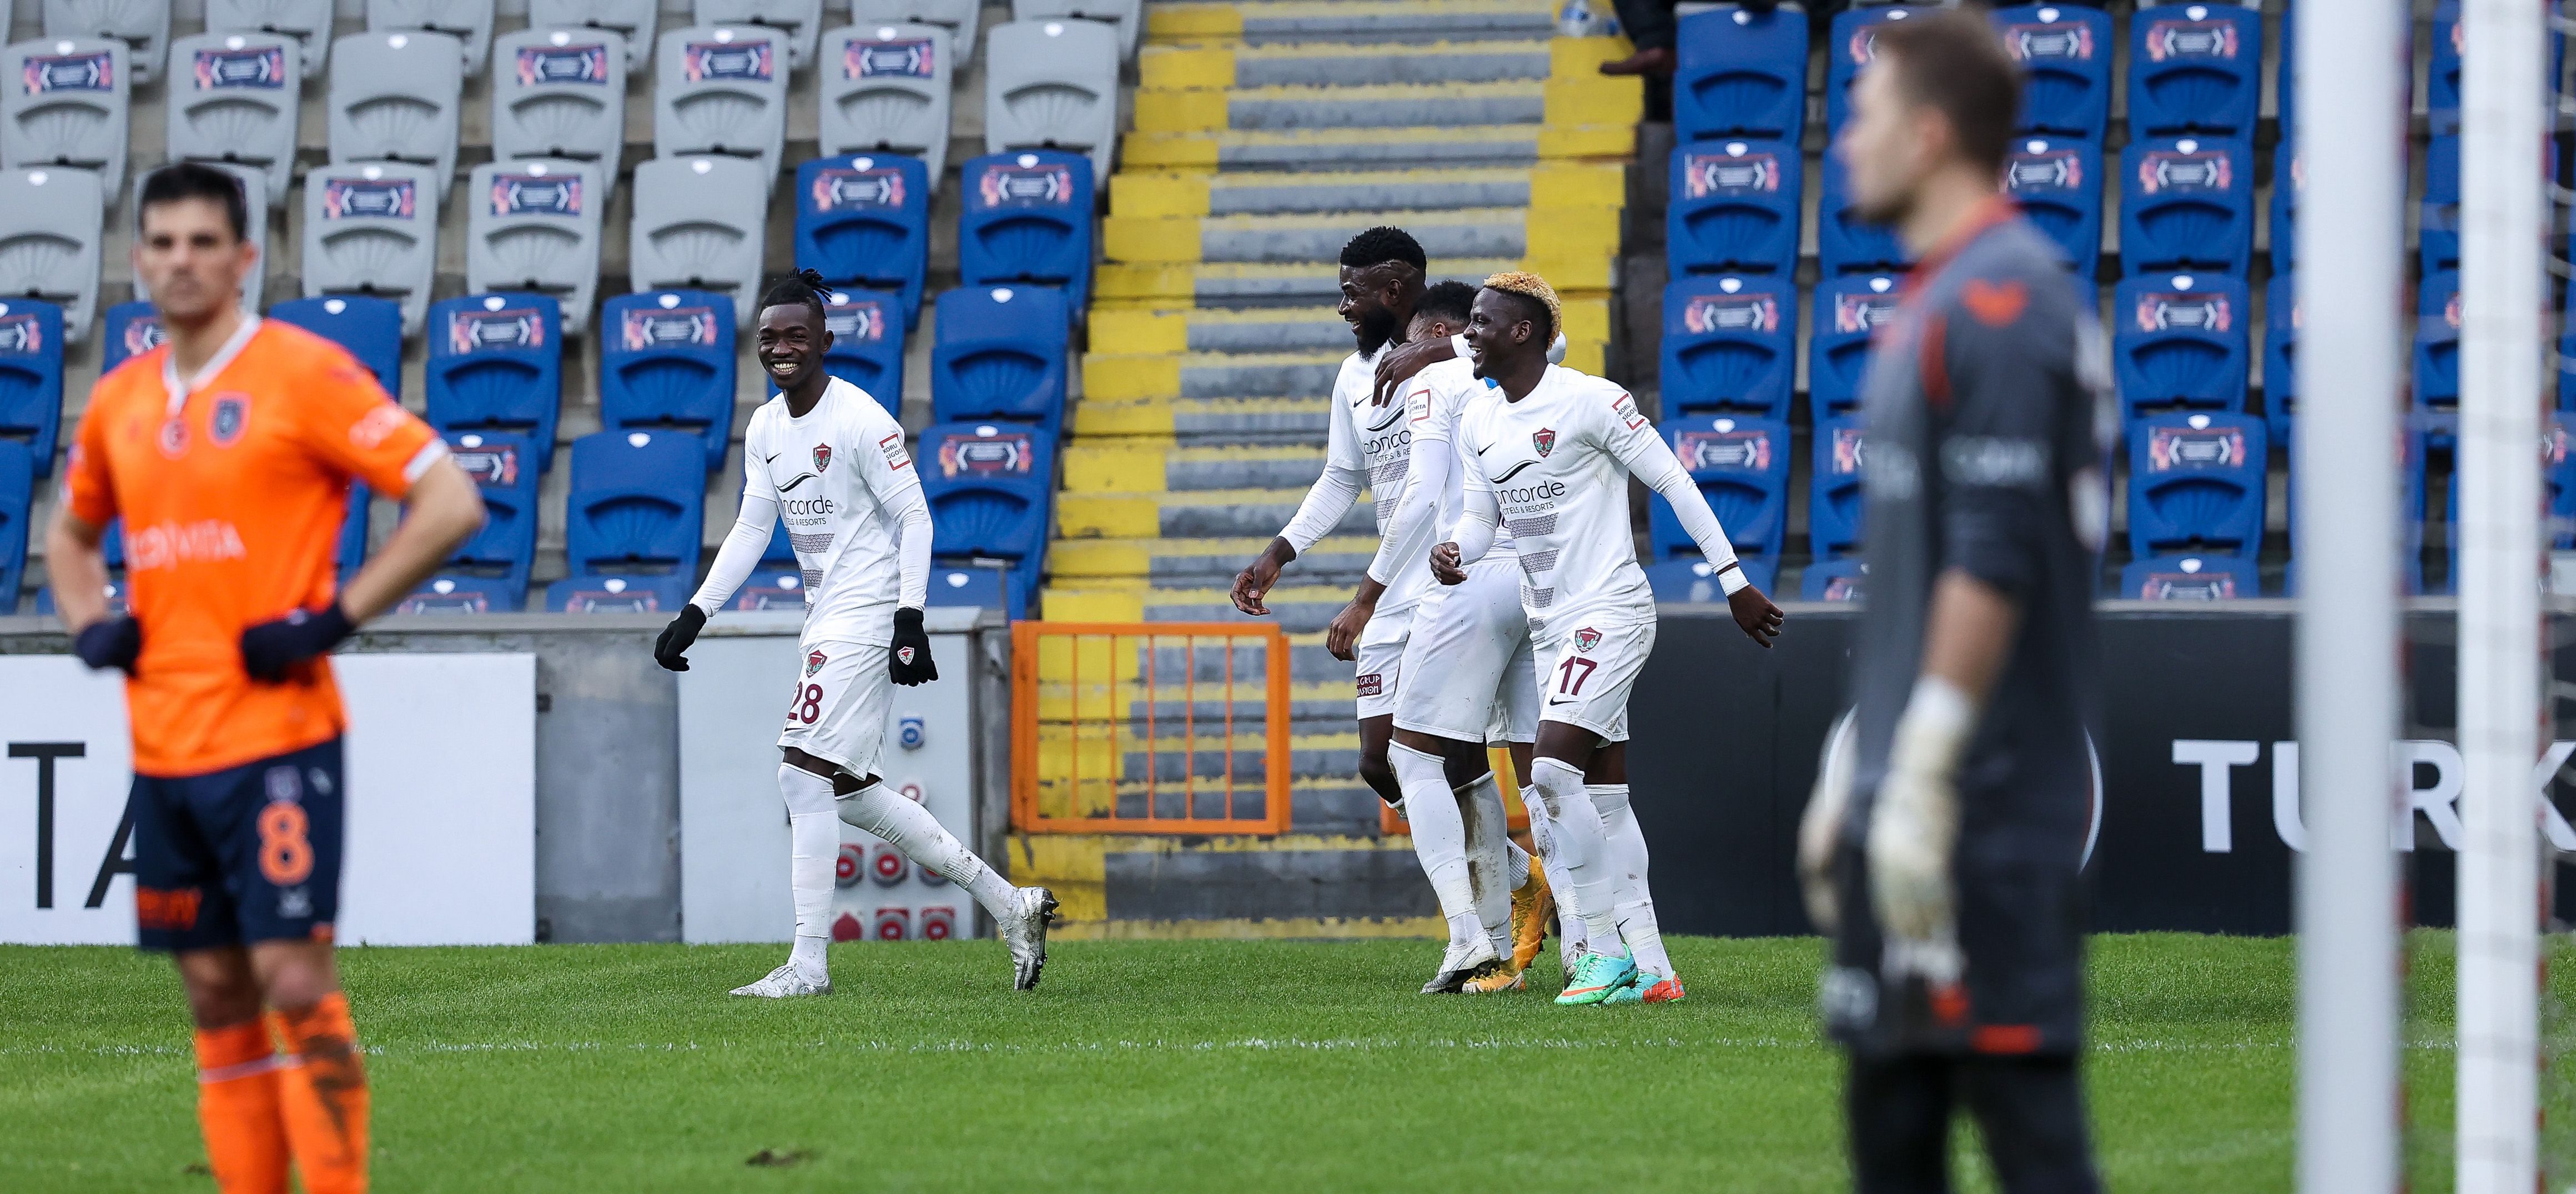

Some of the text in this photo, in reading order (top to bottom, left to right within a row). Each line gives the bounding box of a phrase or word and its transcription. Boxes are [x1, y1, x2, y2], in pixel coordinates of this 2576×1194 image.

[1618, 403, 1631, 416] KORU
[882, 443, 898, 454] KORU
[781, 495, 833, 515] ncorde
[1525, 501, 1554, 513] RESORTS
[799, 517, 827, 526] RESORTS
[1360, 675, 1380, 685] GRUP
[1559, 656, 1597, 696] 17
[788, 681, 823, 724] 28
[257, 800, 315, 887] 8
